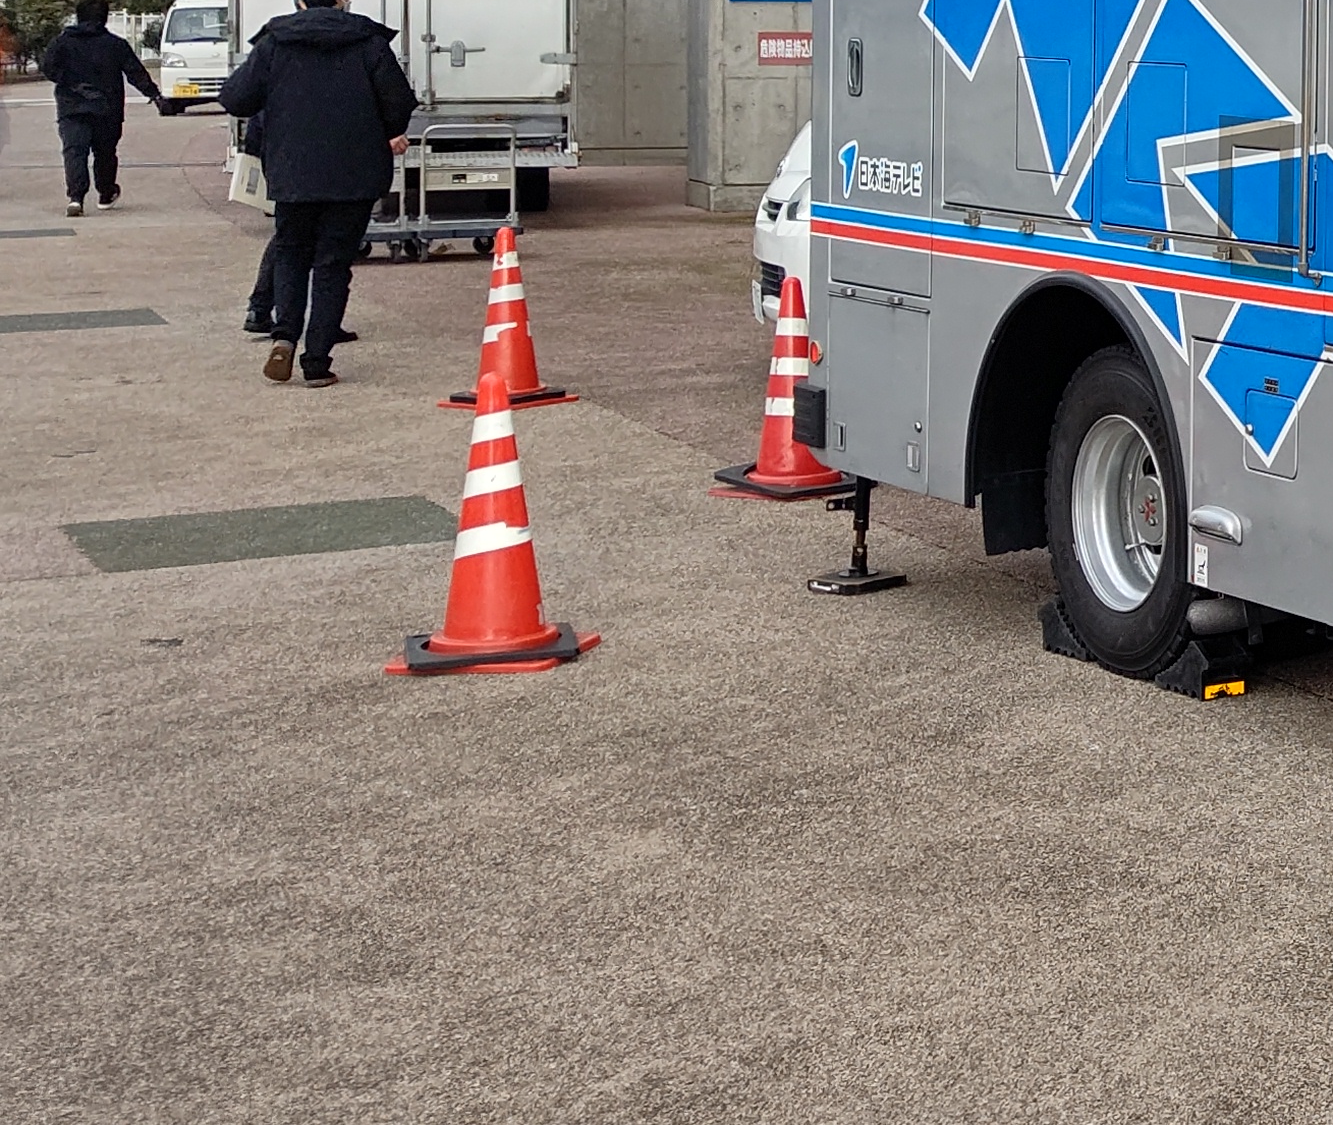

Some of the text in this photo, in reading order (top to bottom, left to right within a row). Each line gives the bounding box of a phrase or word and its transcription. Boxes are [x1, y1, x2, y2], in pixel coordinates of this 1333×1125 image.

[760, 38, 813, 58] 危険物品持込
[859, 158, 922, 195] 日本海テレビ
